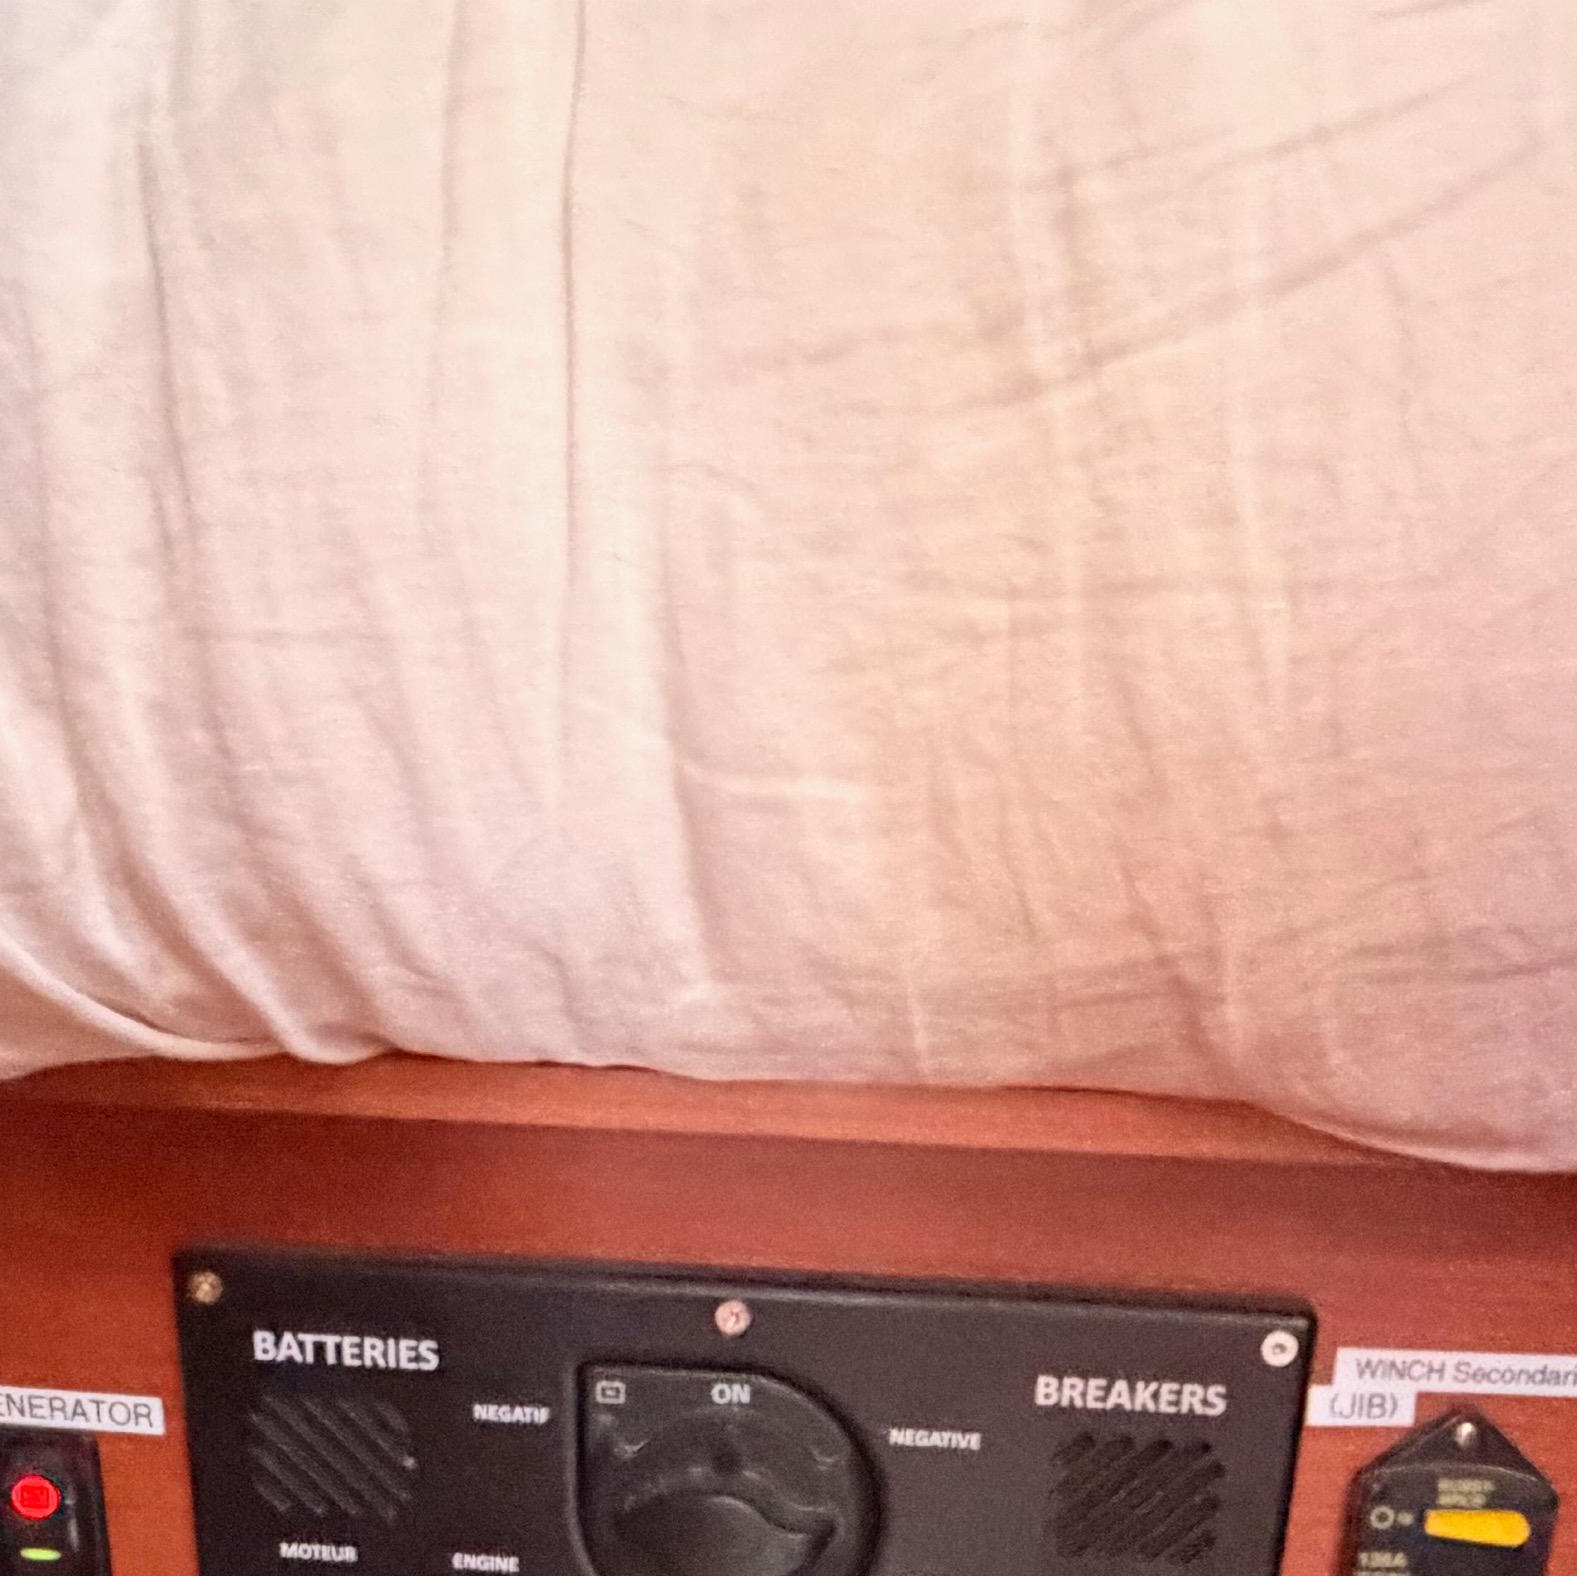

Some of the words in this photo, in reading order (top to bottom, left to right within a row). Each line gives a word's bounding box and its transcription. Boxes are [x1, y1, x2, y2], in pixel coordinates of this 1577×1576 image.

[252, 1329, 440, 1371] BATTERIES
[1354, 1357, 1446, 1384] WINCH
[711, 1384, 751, 1404] ON
[1035, 1375, 1227, 1416] BREAKERS
[1329, 1393, 1399, 1419] (JIB)
[473, 1403, 551, 1424] NEGATIF
[888, 1427, 982, 1451] NEGATIVE
[279, 1542, 358, 1563] MOTEUR
[452, 1552, 520, 1573] ENGINE
